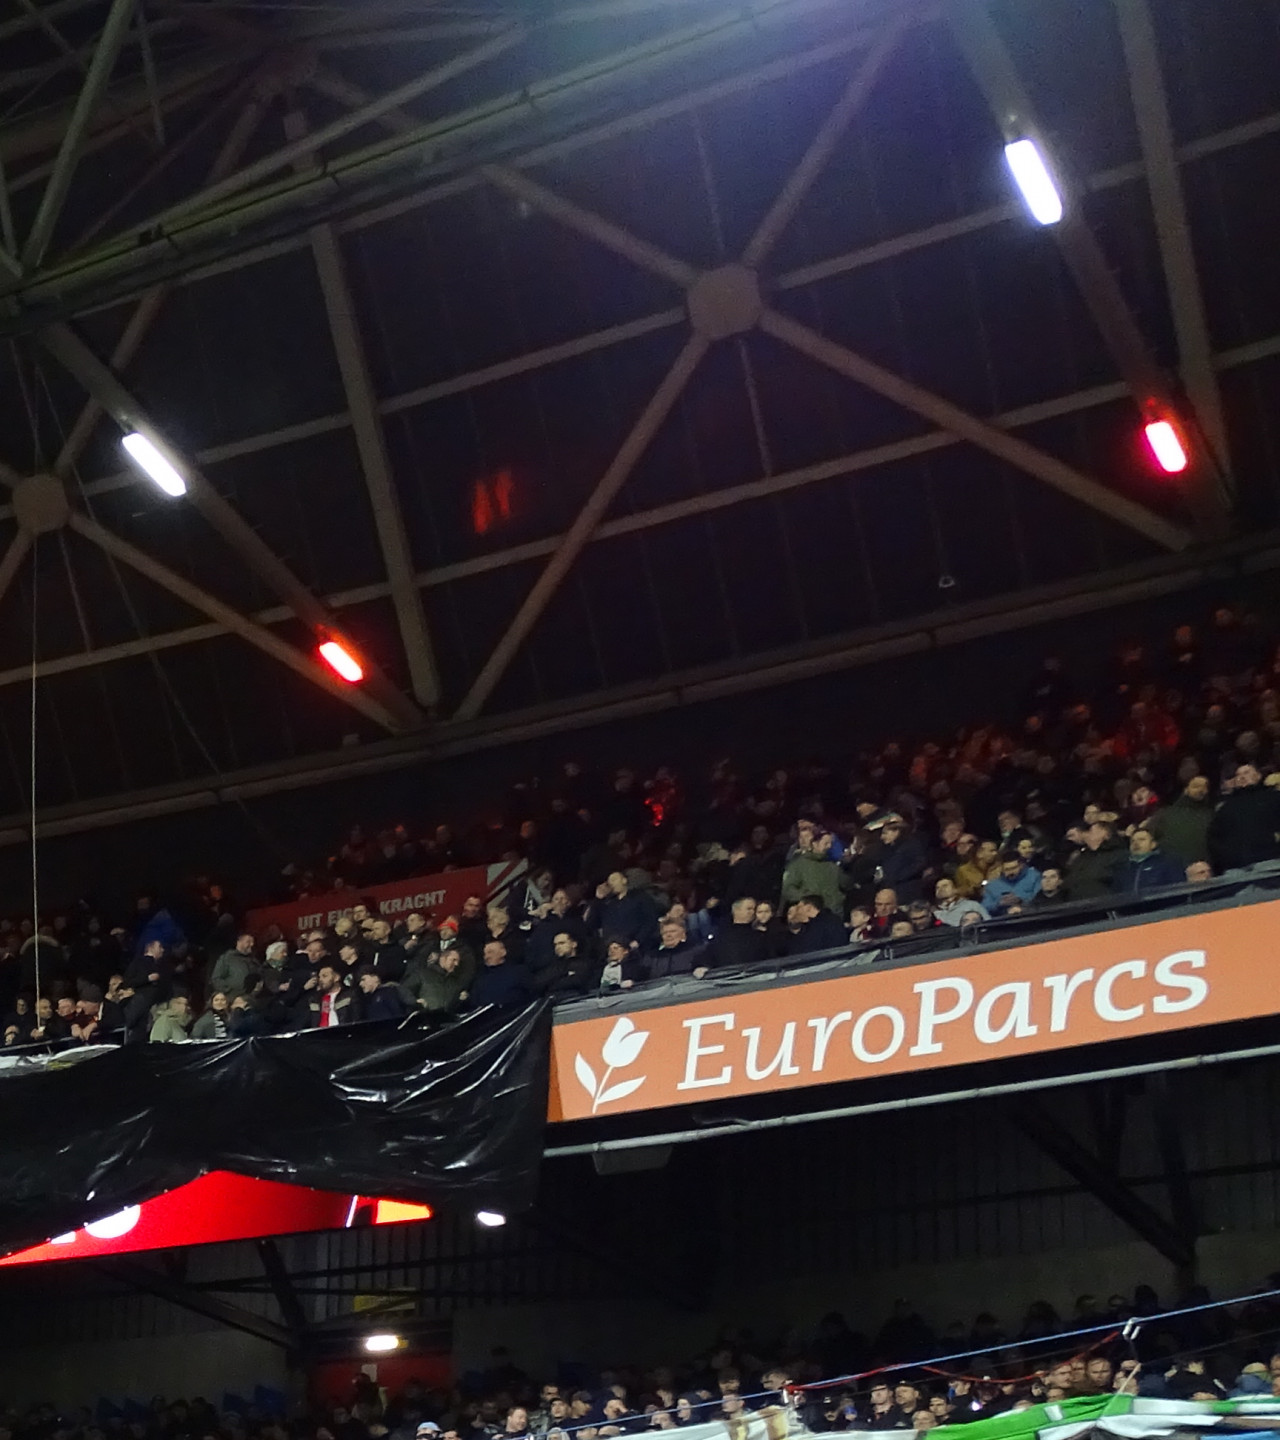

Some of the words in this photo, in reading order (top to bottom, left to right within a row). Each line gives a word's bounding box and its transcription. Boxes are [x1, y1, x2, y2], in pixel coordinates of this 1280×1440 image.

[297, 912, 324, 930] UIT
[379, 889, 447, 914] KRACHT
[676, 949, 1209, 1091] EuroParcs
